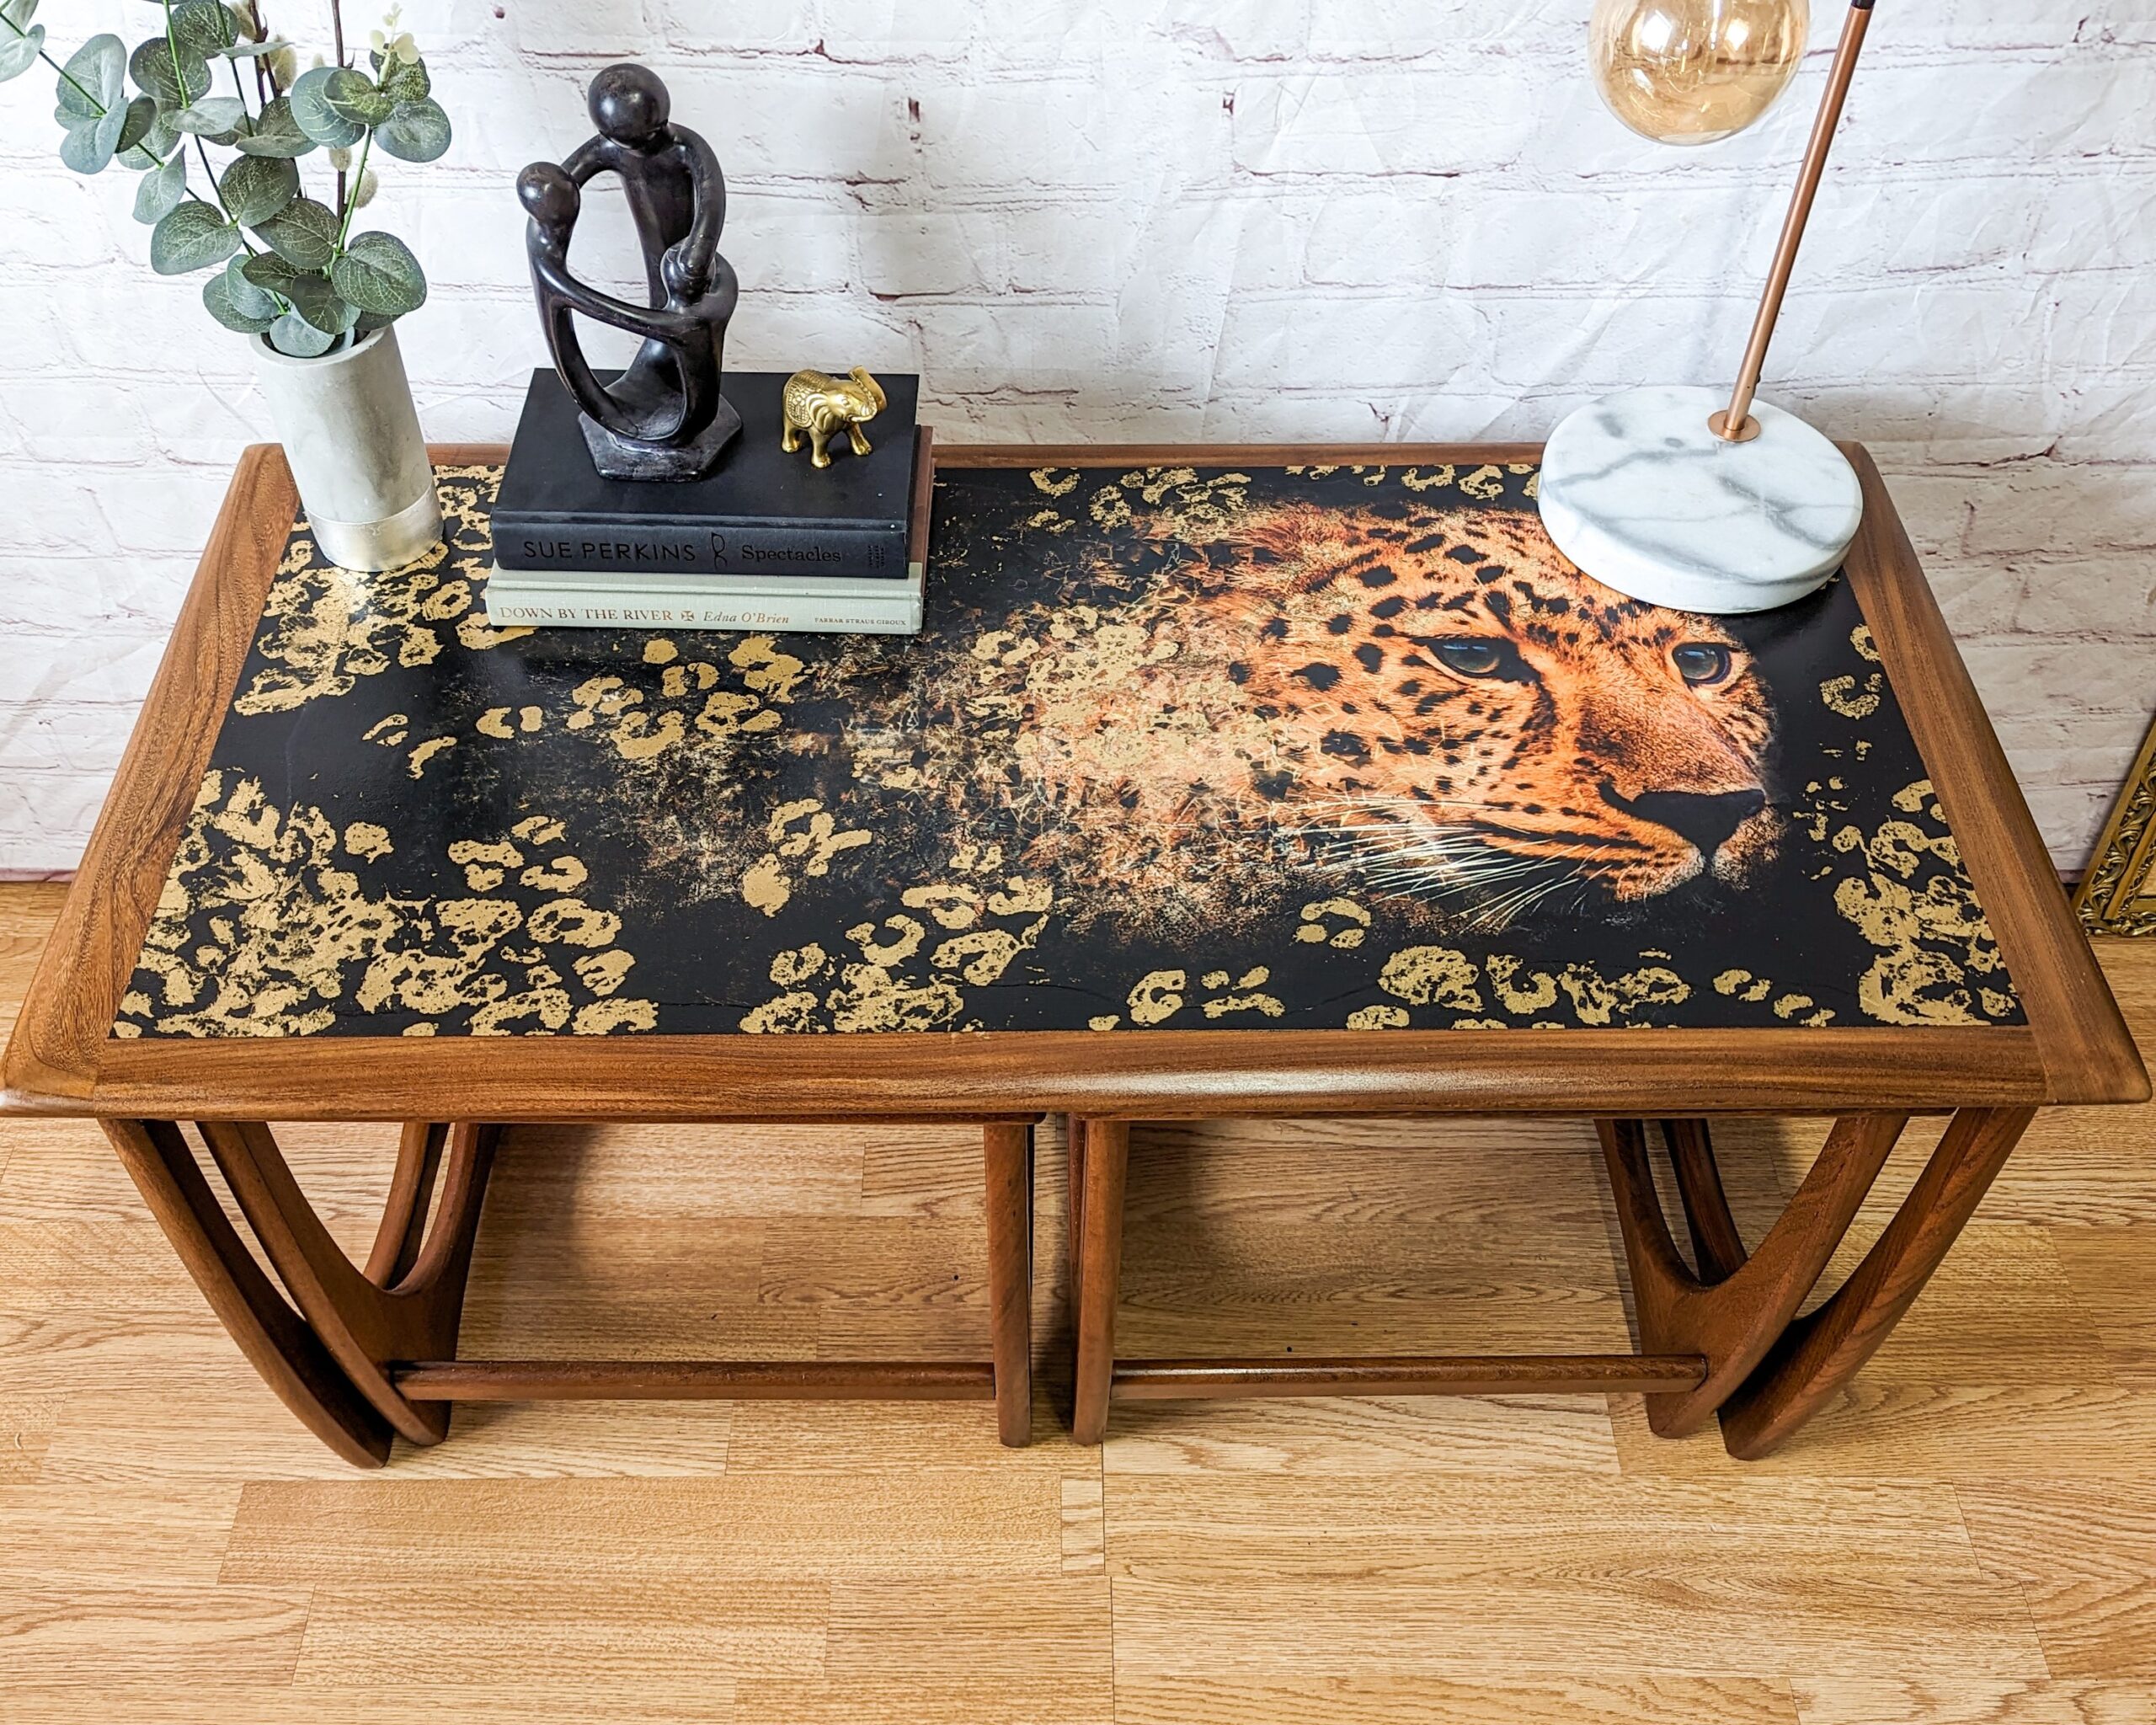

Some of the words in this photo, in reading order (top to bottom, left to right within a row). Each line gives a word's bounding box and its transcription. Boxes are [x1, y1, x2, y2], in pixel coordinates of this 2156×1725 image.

[524, 542, 573, 558] SUE
[583, 542, 696, 561] PERKINS
[741, 544, 841, 563] Spectacles
[499, 606, 552, 618] DOWN
[558, 608, 578, 619] BY
[581, 608, 618, 620] THE
[623, 609, 673, 621] RIVER
[703, 611, 737, 622] Edna
[741, 611, 789, 624] O'Brien
